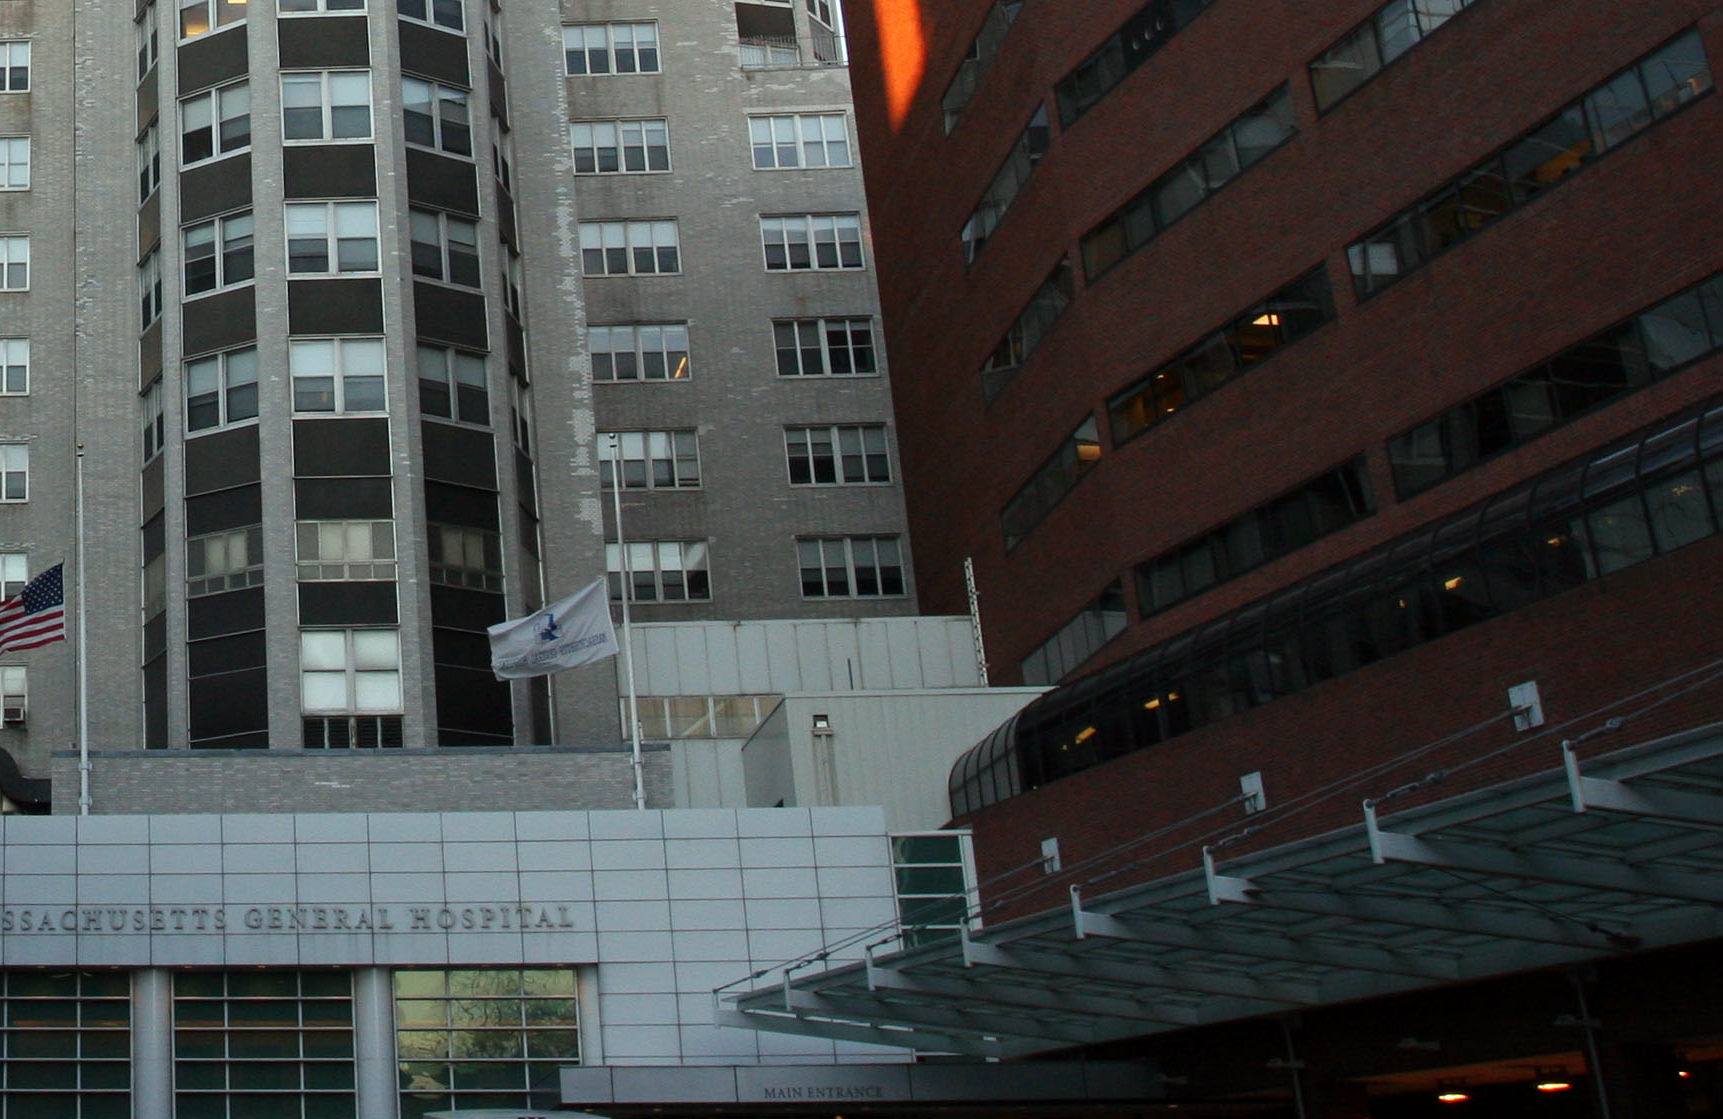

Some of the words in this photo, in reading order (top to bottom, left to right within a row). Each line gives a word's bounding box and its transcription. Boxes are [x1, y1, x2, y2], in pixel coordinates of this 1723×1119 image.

[244, 908, 394, 931] GENERAL
[409, 906, 574, 930] HOSPITAL
[764, 1087, 802, 1099] MAIN
[807, 1086, 884, 1098] ENTRANCE
